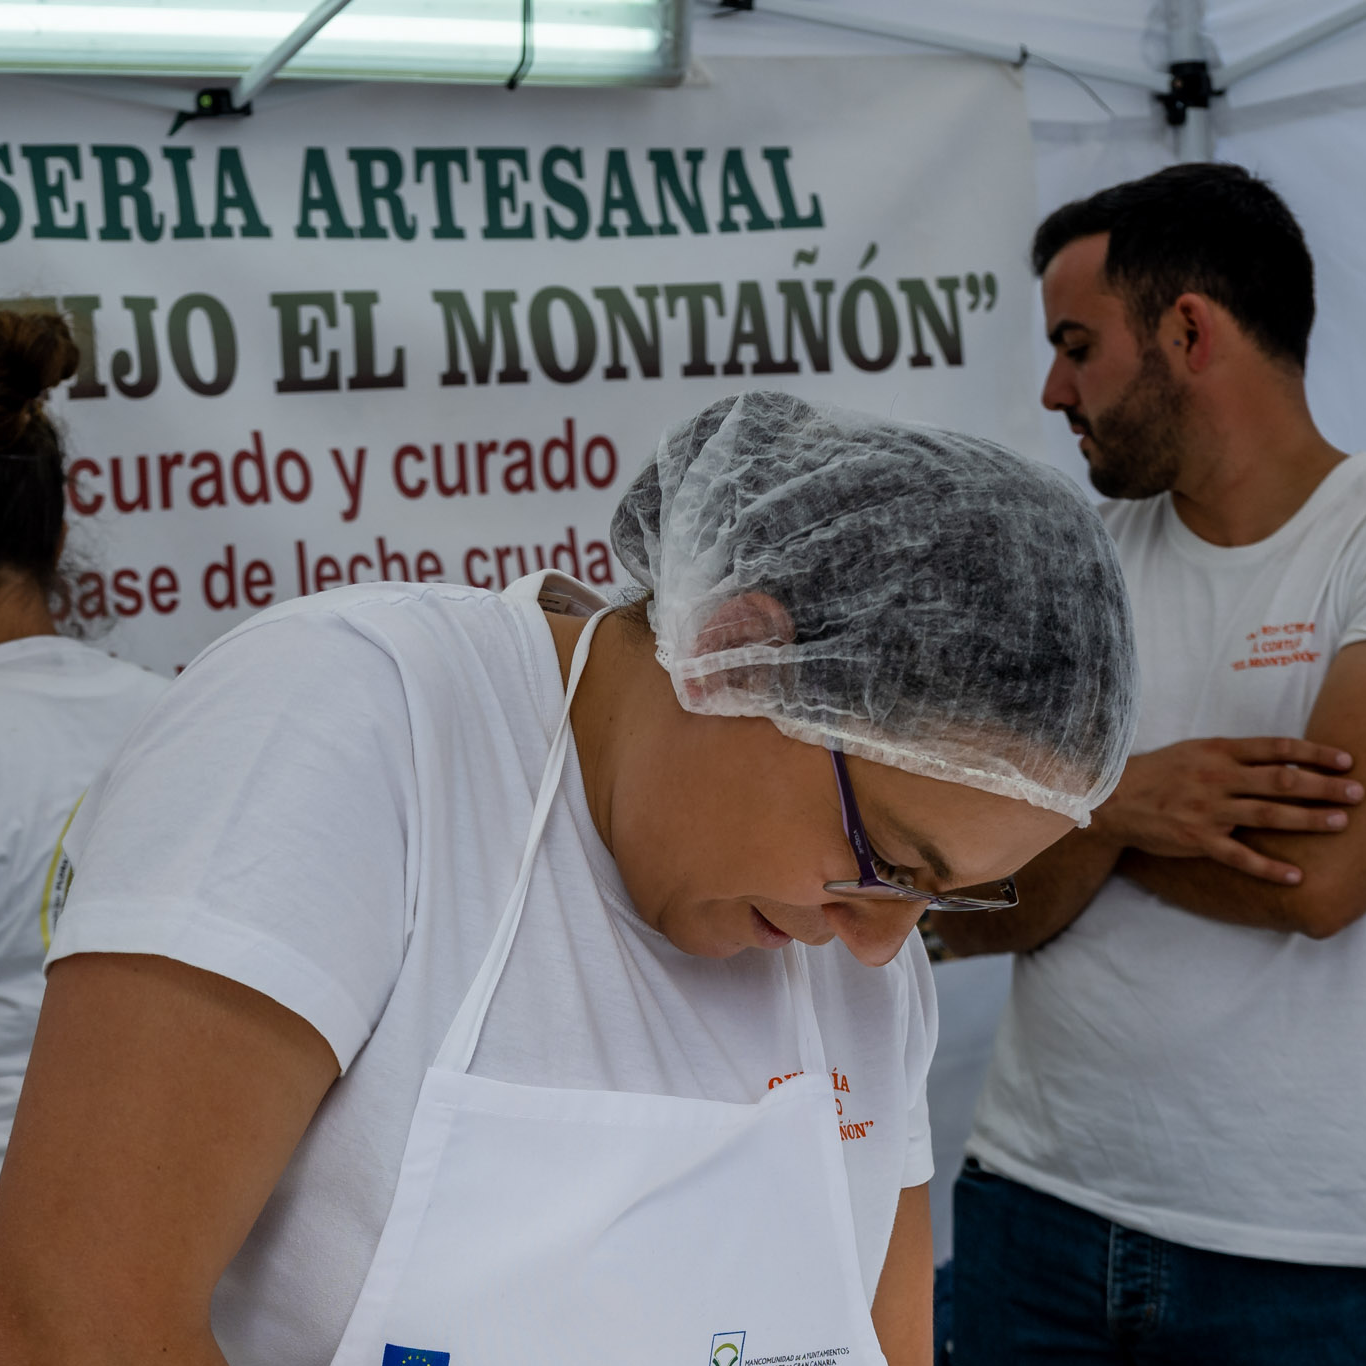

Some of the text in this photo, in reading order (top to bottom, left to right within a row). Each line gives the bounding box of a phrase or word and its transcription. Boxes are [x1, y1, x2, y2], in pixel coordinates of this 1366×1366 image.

[294, 145, 824, 241] ARTESANAL
[270, 289, 406, 394] EL
[434, 244, 998, 388] MONTAÑÓN”
[330, 446, 367, 523] y
[391, 417, 619, 500] curado
[201, 543, 276, 612] de
[295, 536, 444, 597] leche
[744, 1355, 795, 1366] MANCOMUNIDAD
